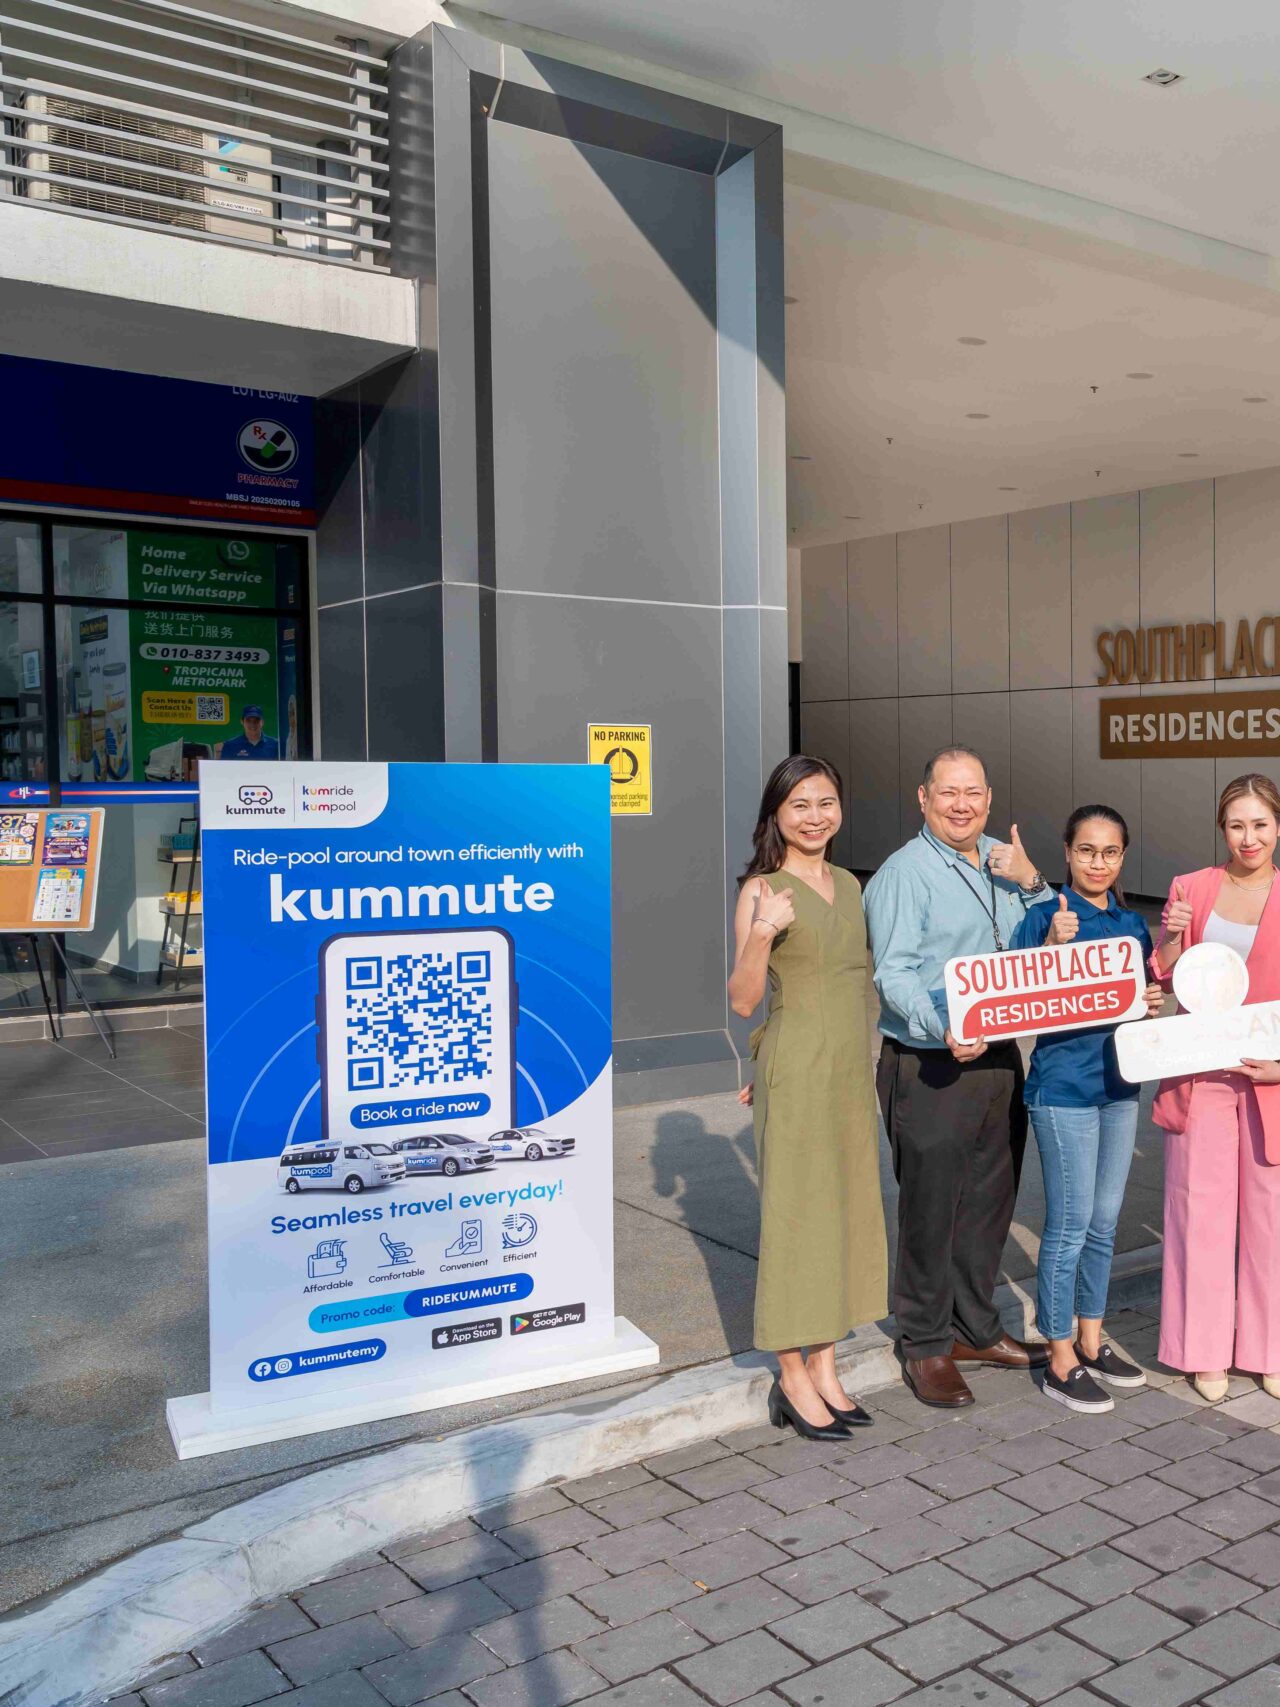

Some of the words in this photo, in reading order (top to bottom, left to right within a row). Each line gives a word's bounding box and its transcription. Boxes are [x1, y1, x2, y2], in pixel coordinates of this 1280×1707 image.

[238, 473, 299, 488] PHARMACY
[225, 493, 249, 502] MBSJ
[251, 495, 300, 508] 20250200105
[141, 545, 187, 560] Home
[141, 563, 206, 582] Delivery
[209, 568, 263, 584] Service
[143, 581, 167, 595] Via
[171, 583, 247, 602] Whatsapp
[144, 621, 234, 639] 送货上门服务
[160, 646, 222, 661] 010-837
[225, 650, 260, 662] 3493
[174, 665, 244, 678] TROPICANA
[171, 676, 247, 688] METROPARK
[594, 731, 606, 741] NO
[608, 731, 646, 742] PARKING
[302, 785, 354, 797] kumride
[225, 803, 286, 816] kummute
[302, 800, 356, 814] kumpool
[233, 847, 330, 870] Ride-pool
[335, 846, 403, 863] around
[408, 847, 455, 862] town
[458, 843, 542, 865] efficiently
[546, 842, 584, 859] with
[269, 873, 555, 923] kummute
[954, 944, 1112, 996] SOUTHPLACE
[1118, 941, 1135, 974] 2
[980, 989, 1120, 1027] RESIDENCES
[360, 1103, 398, 1122] Book
[401, 1106, 412, 1118] a
[415, 1100, 445, 1116] ride
[448, 1098, 480, 1113] now
[291, 1165, 332, 1176] kumpool
[271, 1205, 383, 1235] Seamless
[389, 1192, 453, 1219] travel
[459, 1179, 564, 1210] everyday!
[502, 1250, 538, 1263] Efficient
[439, 1257, 489, 1273] Convenient
[368, 1267, 425, 1284] Comfortable
[303, 1278, 354, 1294] Affordable
[320, 1307, 360, 1325] Promo
[363, 1301, 396, 1318] code:
[422, 1281, 518, 1307] RIDEKUMMUTE
[532, 1316, 563, 1328] Google
[564, 1312, 581, 1322] Play
[452, 1325, 478, 1334] Download
[452, 1332, 471, 1343] App
[473, 1327, 497, 1339] Store
[299, 1343, 379, 1368] kummutemy
